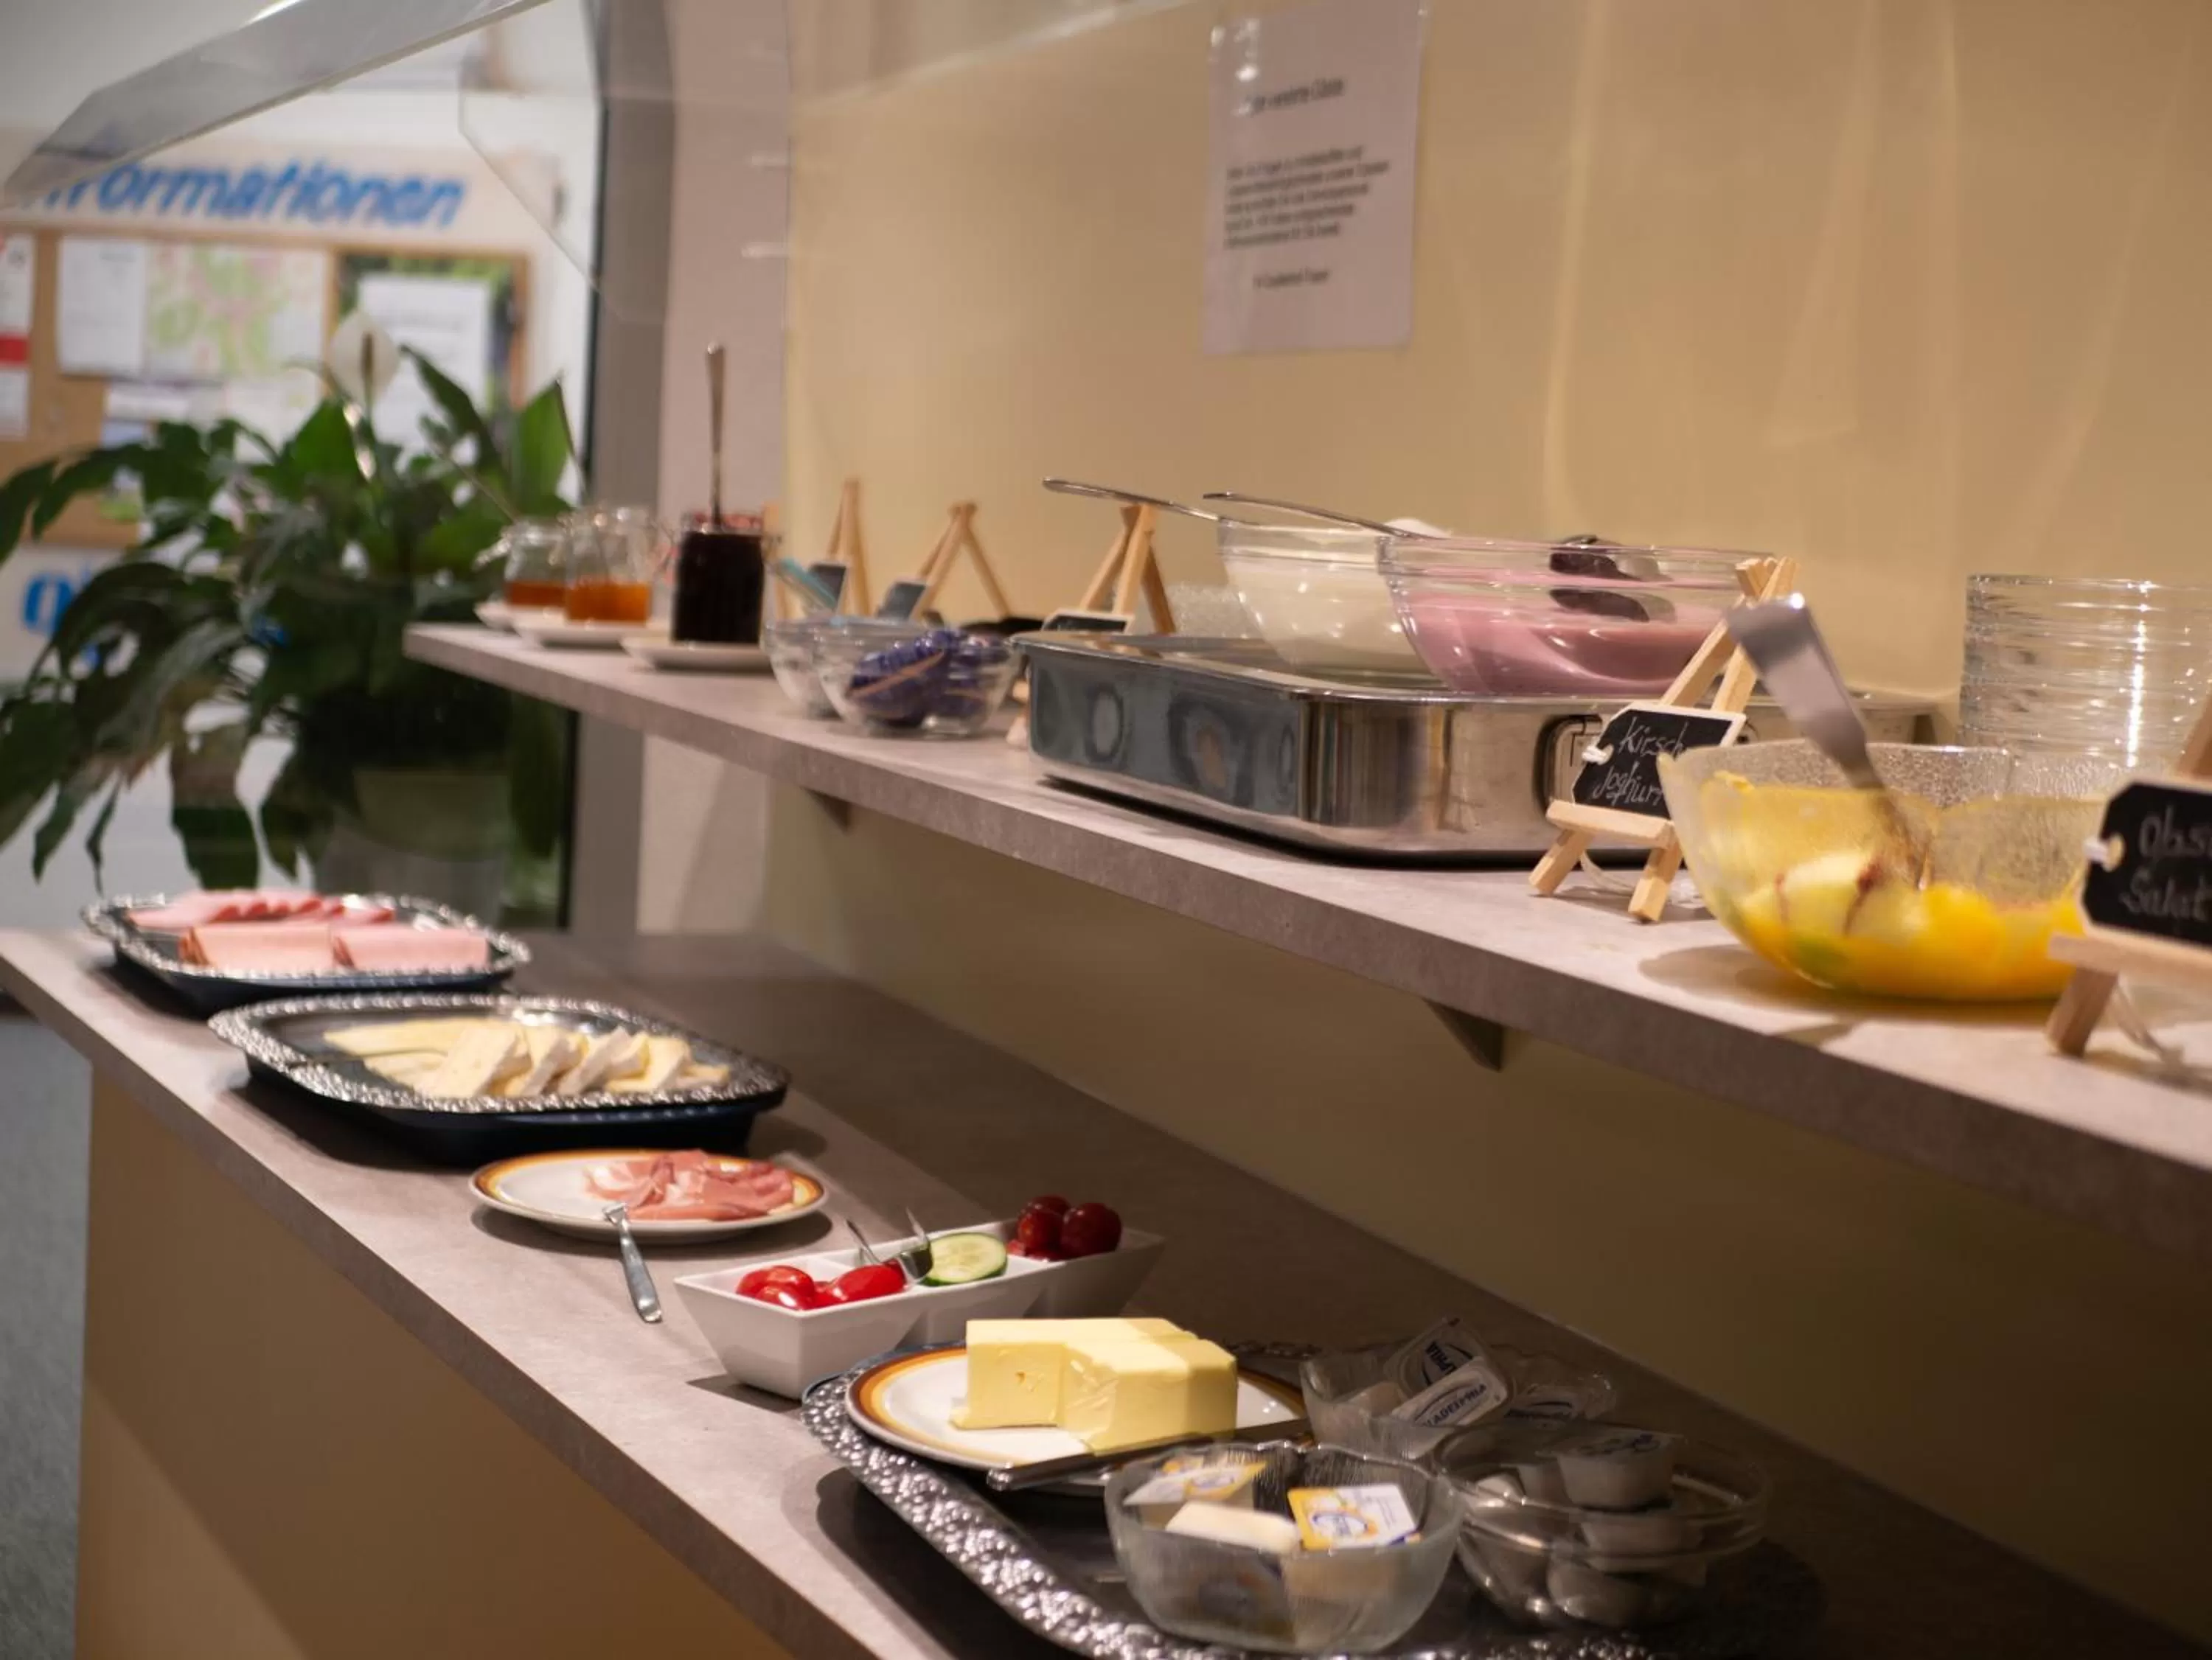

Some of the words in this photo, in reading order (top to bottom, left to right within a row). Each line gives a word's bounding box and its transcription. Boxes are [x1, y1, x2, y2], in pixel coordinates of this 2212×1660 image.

[22, 157, 465, 226] formationen
[1618, 716, 1688, 759] Kirsch
[2140, 804, 2212, 860] Obs
